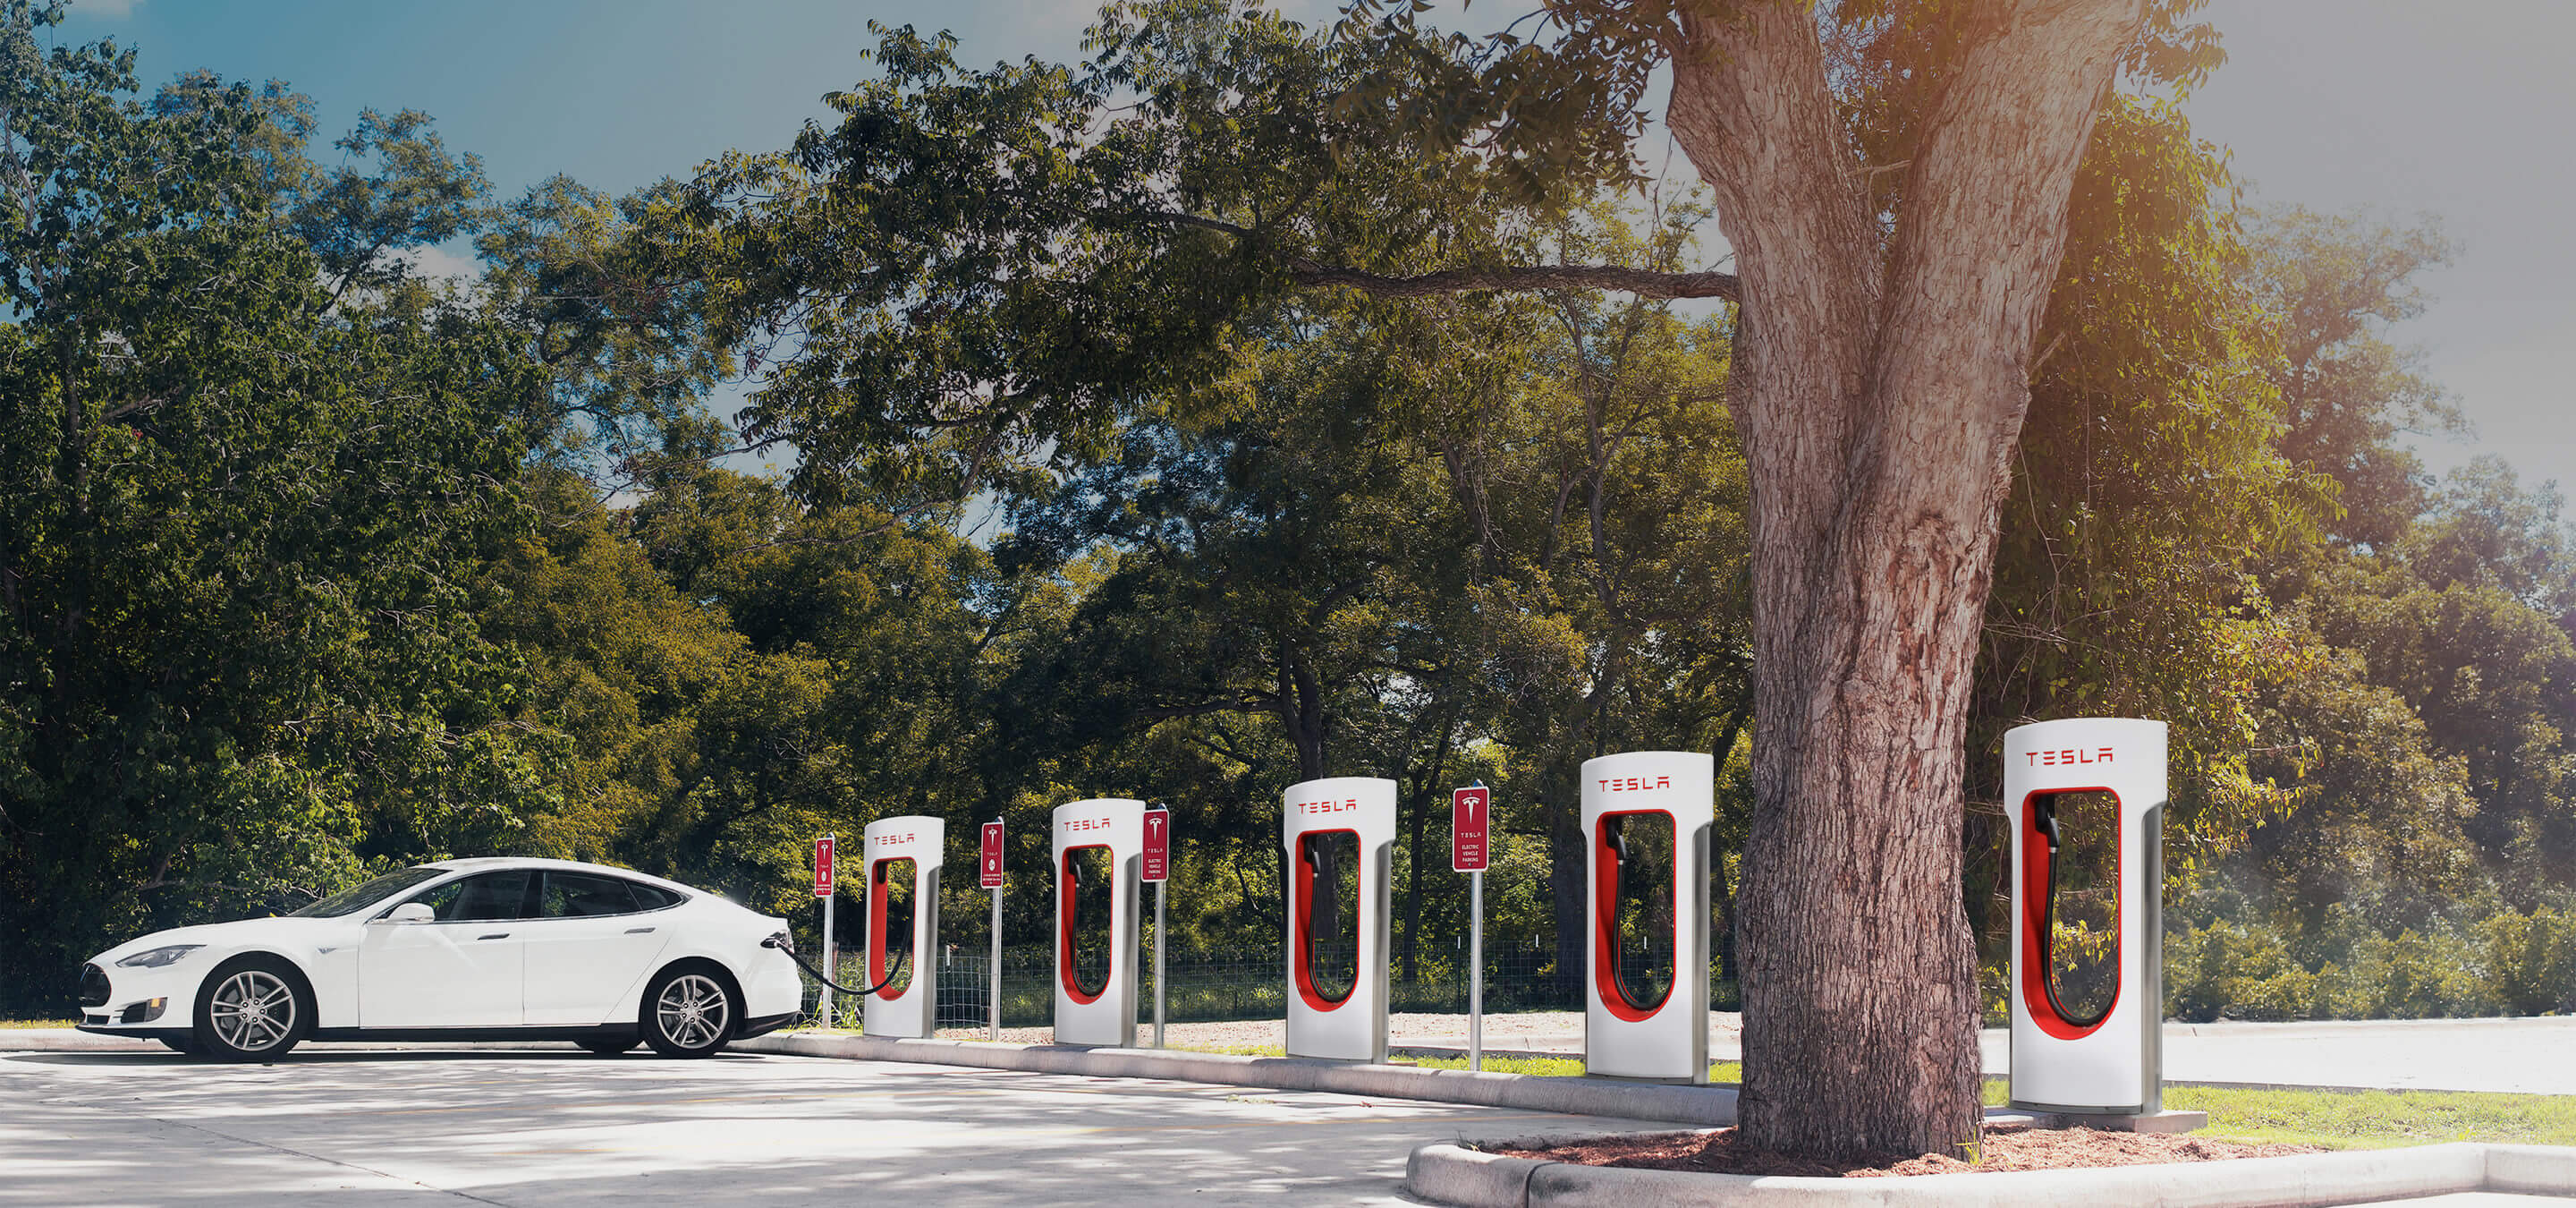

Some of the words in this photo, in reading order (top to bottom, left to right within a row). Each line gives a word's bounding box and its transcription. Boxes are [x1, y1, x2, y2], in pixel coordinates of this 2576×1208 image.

[2025, 747, 2113, 767] TESLA
[1598, 776, 1670, 793] TESLA
[1298, 799, 1356, 814] TESLA
[1064, 818, 1110, 831] TESLA
[874, 833, 915, 846] TESLA
